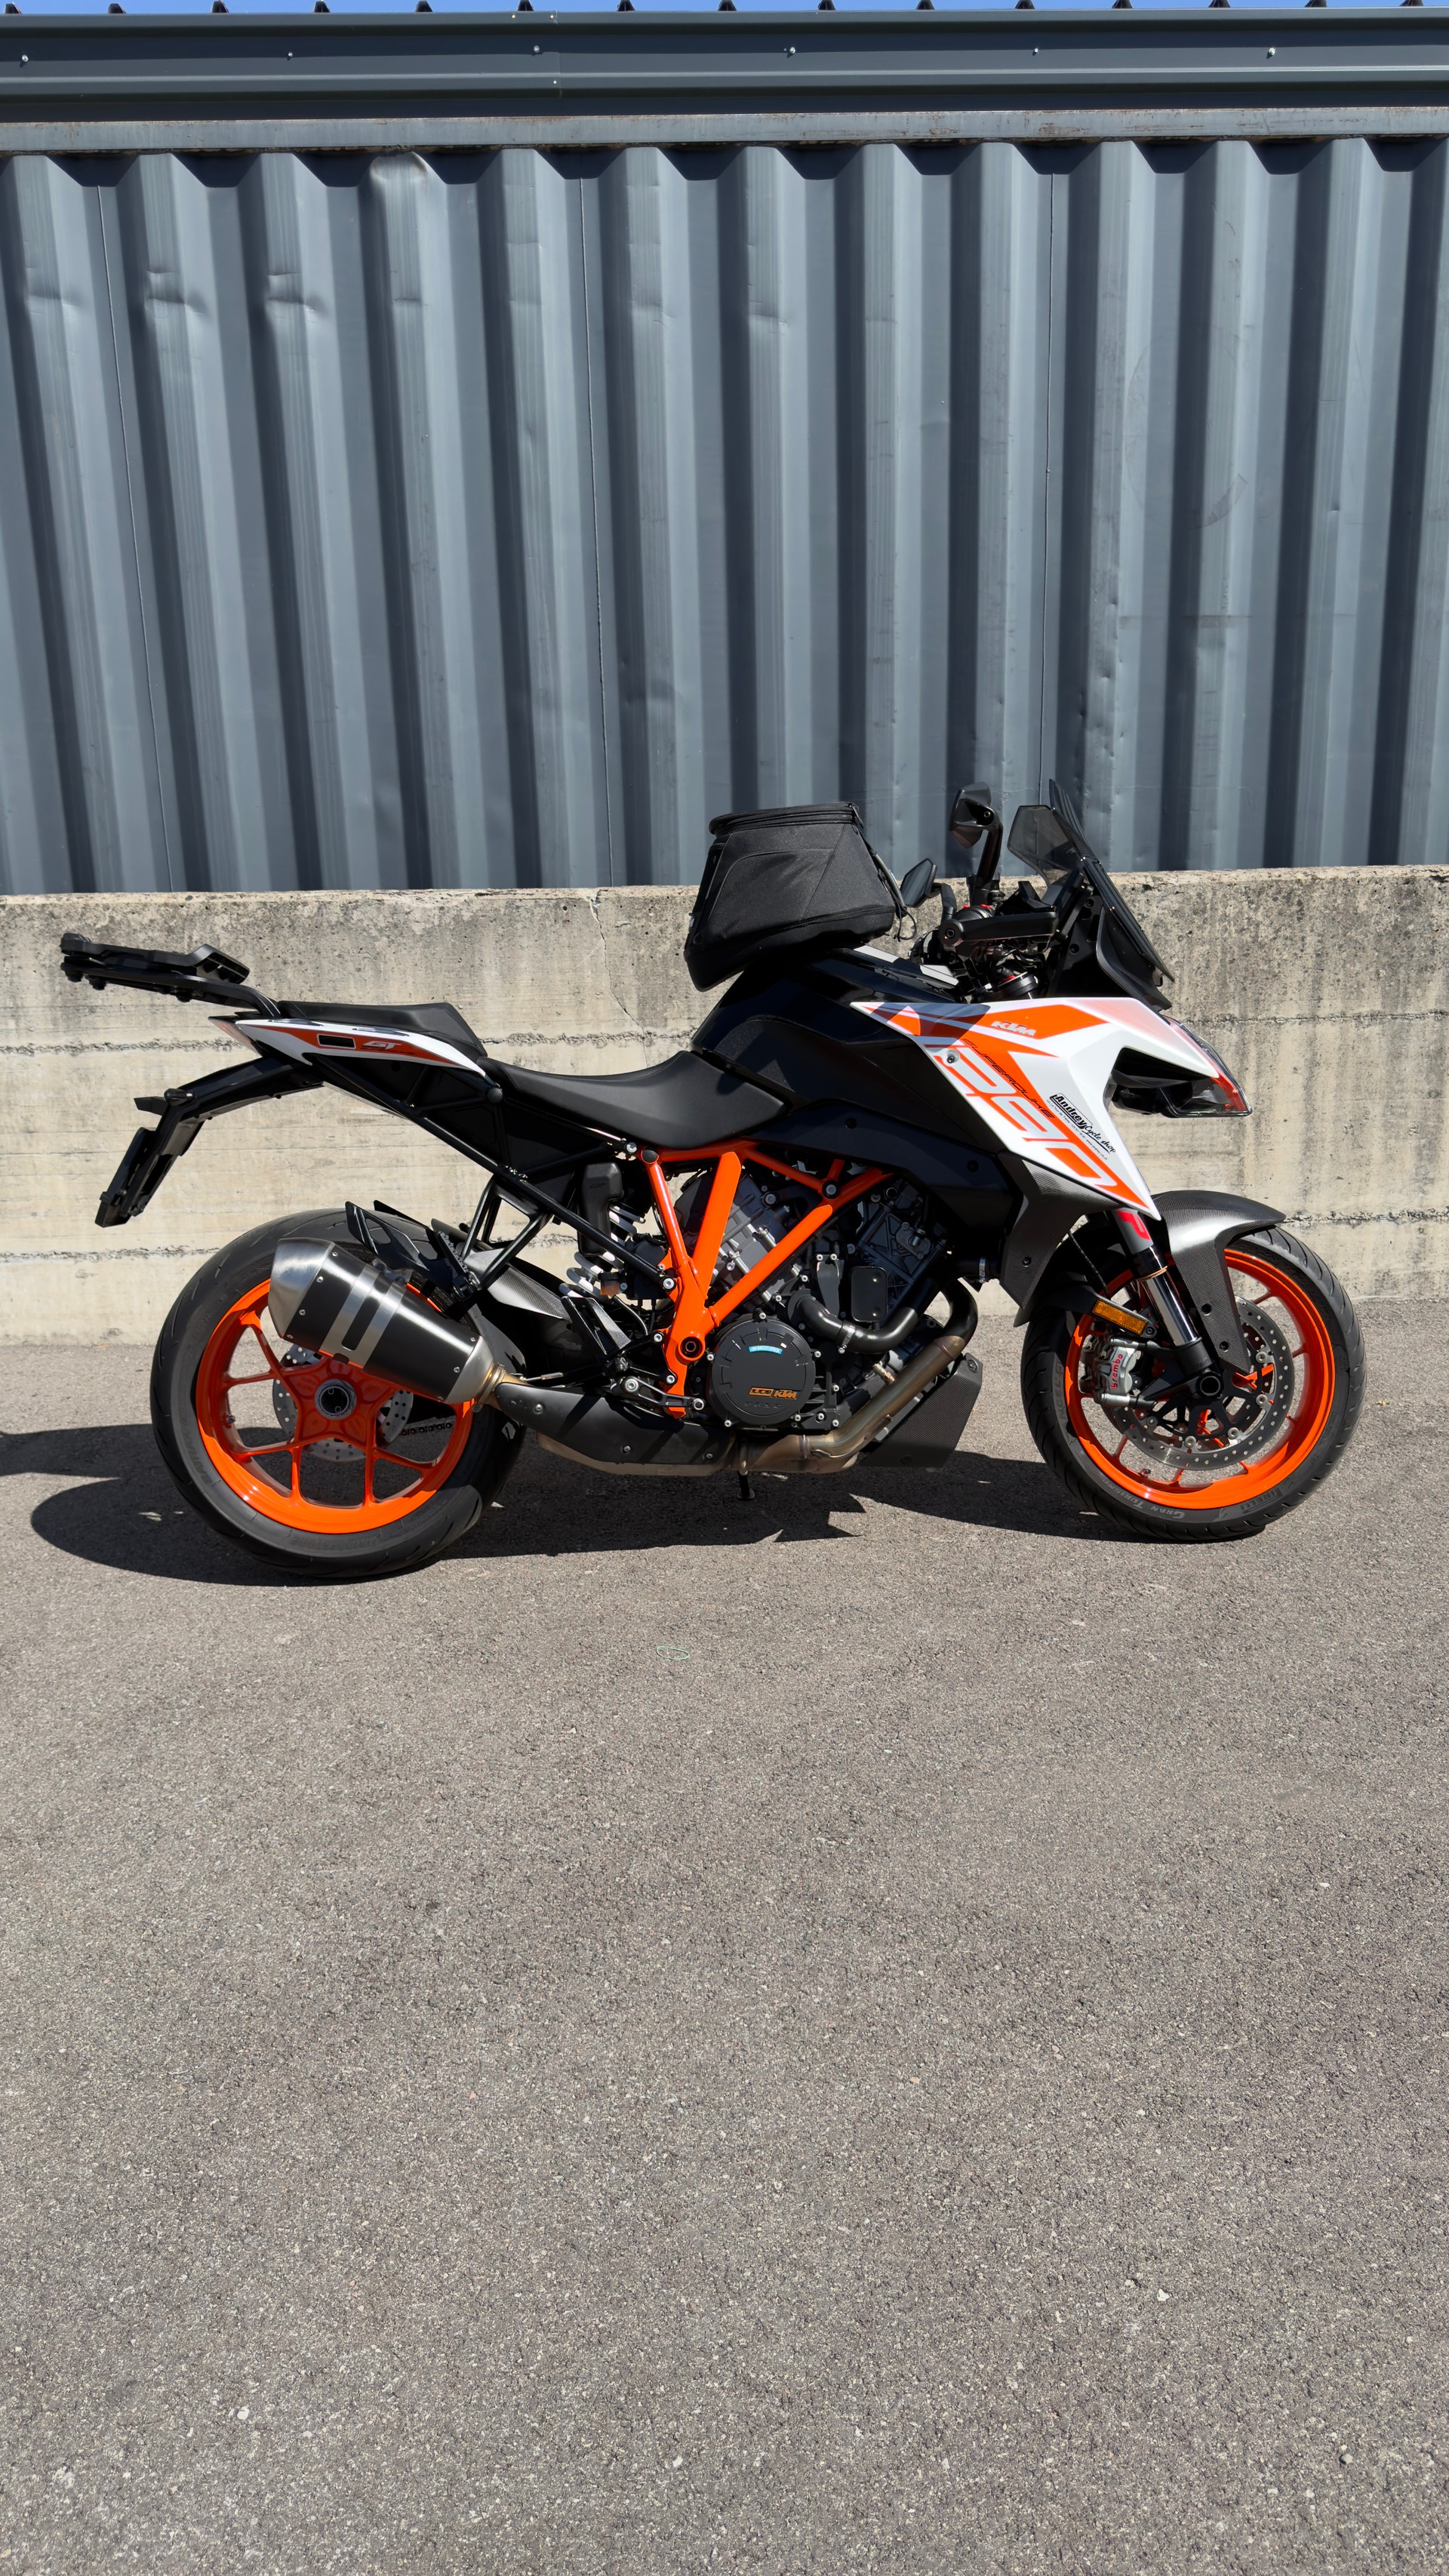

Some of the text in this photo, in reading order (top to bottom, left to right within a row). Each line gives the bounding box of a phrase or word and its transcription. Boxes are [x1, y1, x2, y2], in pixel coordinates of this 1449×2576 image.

[990, 1020, 1036, 1037] KTM
[363, 1041, 402, 1050] GT
[1055, 1095, 1087, 1127] Andrey
[1084, 1125, 1101, 1140] Cycle
[1101, 1140, 1116, 1153] shop
[1110, 1354, 1123, 1389] brembo
[774, 1390, 798, 1399] KTM
